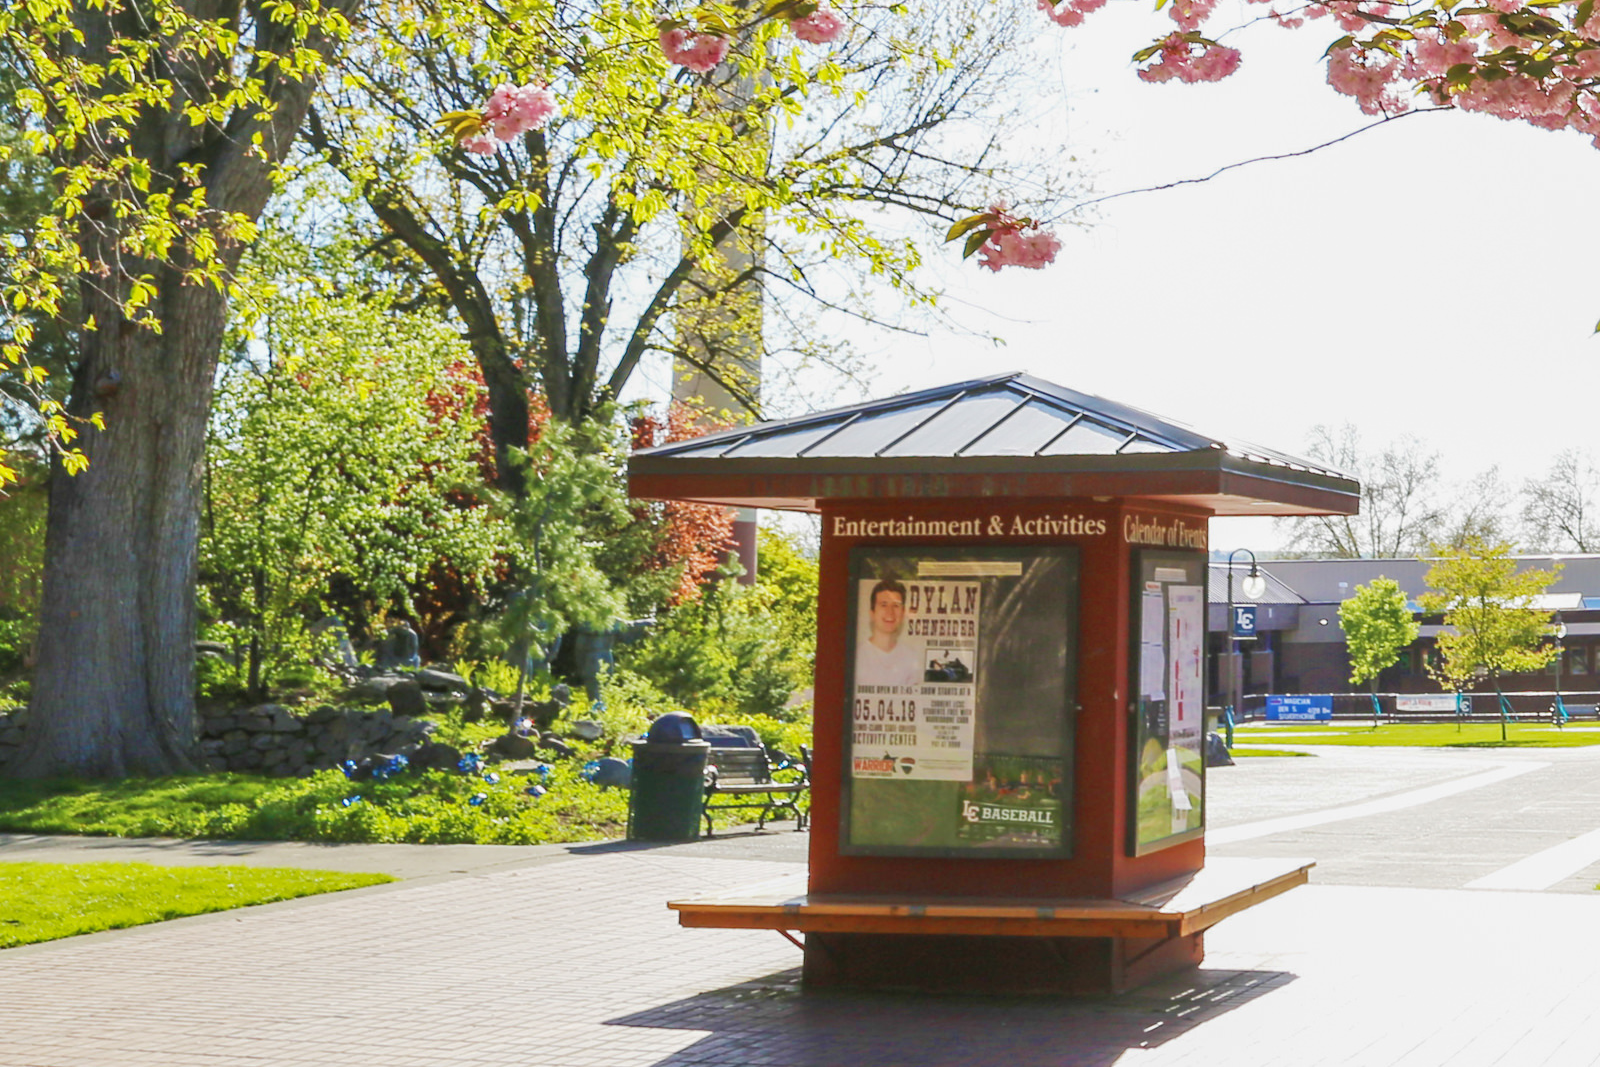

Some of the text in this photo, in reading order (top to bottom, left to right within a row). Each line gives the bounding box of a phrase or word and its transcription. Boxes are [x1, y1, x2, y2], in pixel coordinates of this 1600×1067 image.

[833, 514, 1106, 536] Entertainment & Activities
[1124, 515, 1206, 549] Calendar of Events
[909, 585, 978, 614] DYLAN
[908, 619, 975, 636] SCHNEIDER
[1236, 608, 1254, 630] LC
[855, 699, 916, 722] 05.04.18
[889, 734, 917, 746] CENTER
[854, 759, 894, 772] WARRIOR
[962, 800, 1054, 824] LC BASEBALL
